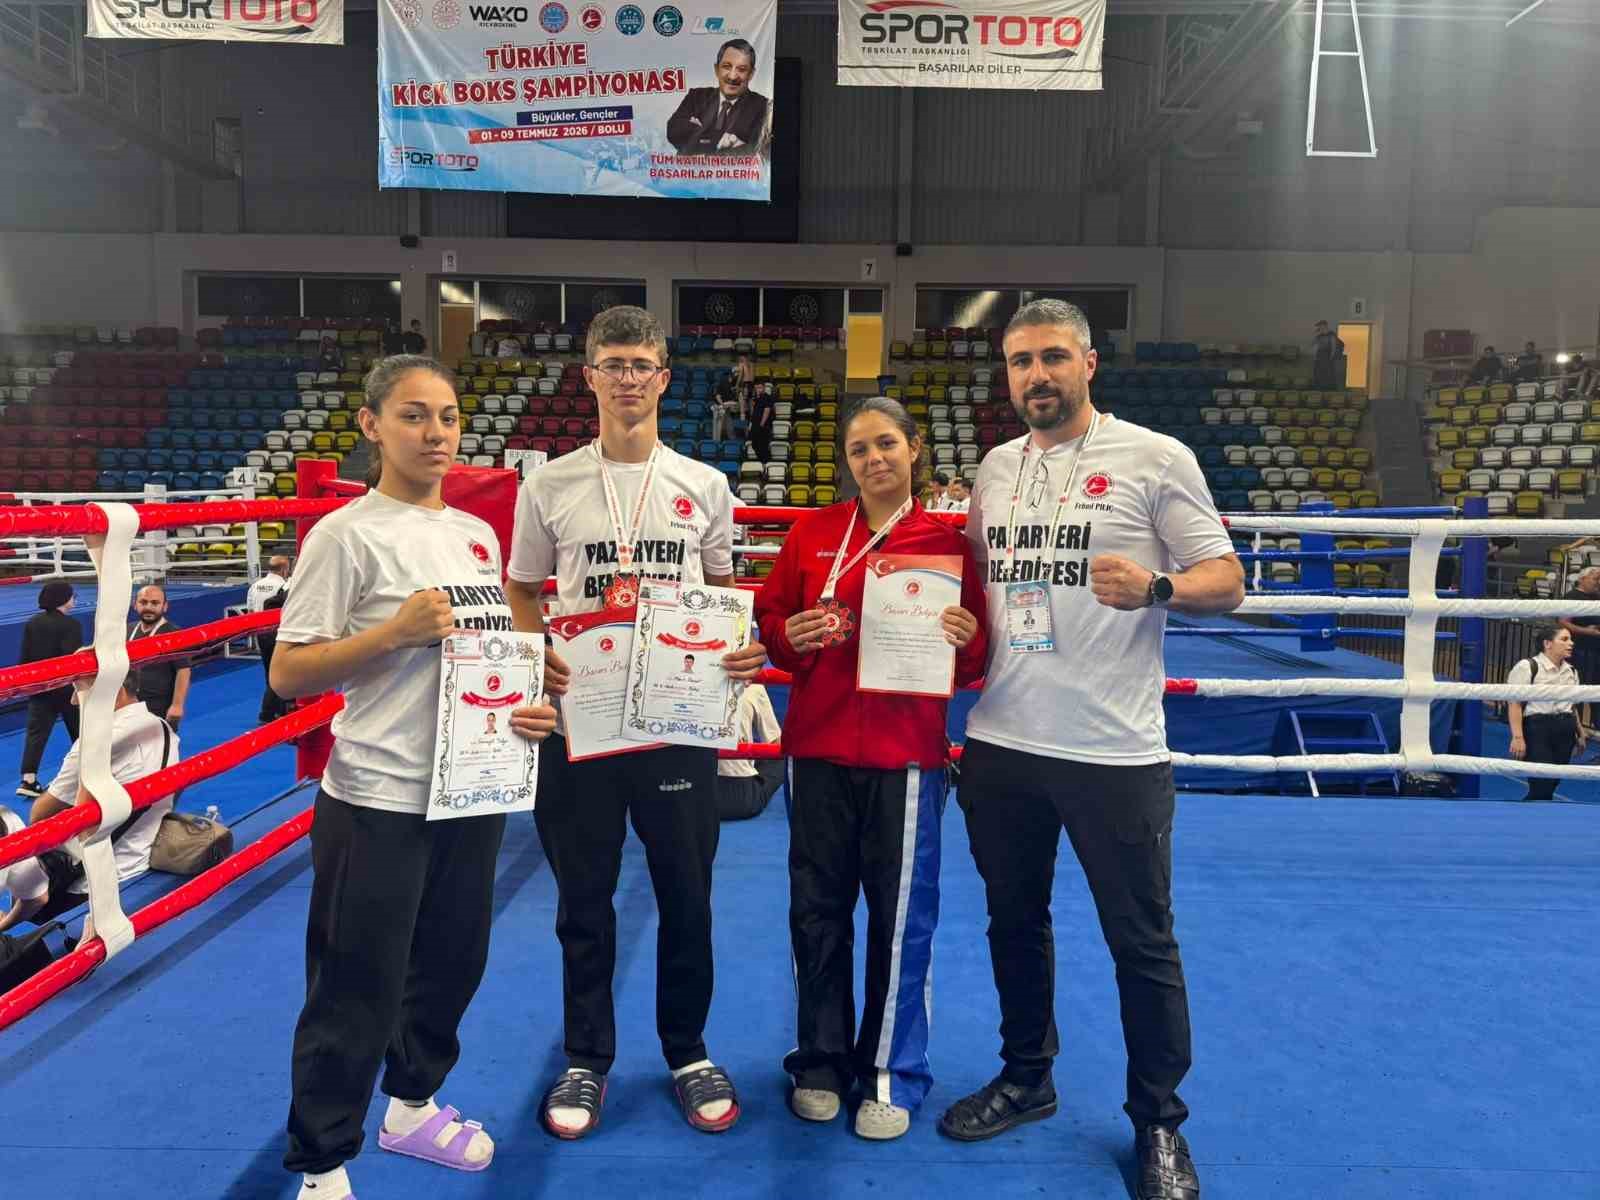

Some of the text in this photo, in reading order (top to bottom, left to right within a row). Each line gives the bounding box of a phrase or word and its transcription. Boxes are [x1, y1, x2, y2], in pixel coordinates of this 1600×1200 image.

[469, 6, 528, 22] WAKO
[485, 40, 587, 70] TÜRKİYE
[918, 63, 1022, 75] BAŞARILAR DİLER
[453, 80, 517, 104] BOKS
[523, 69, 685, 104] ŞAMPİYONASI
[580, 110, 618, 121] Gençler
[481, 131, 492, 140] 01
[500, 130, 513, 140] 09
[517, 127, 559, 139] TEMMUZ
[563, 126, 588, 136] 2026
[598, 124, 625, 134] BOLU
[866, 263, 873, 276] 7
[585, 538, 685, 565] PAZRYERİ
[990, 556, 1088, 587] BEEDİESİ
[430, 584, 507, 607] ZARYE
